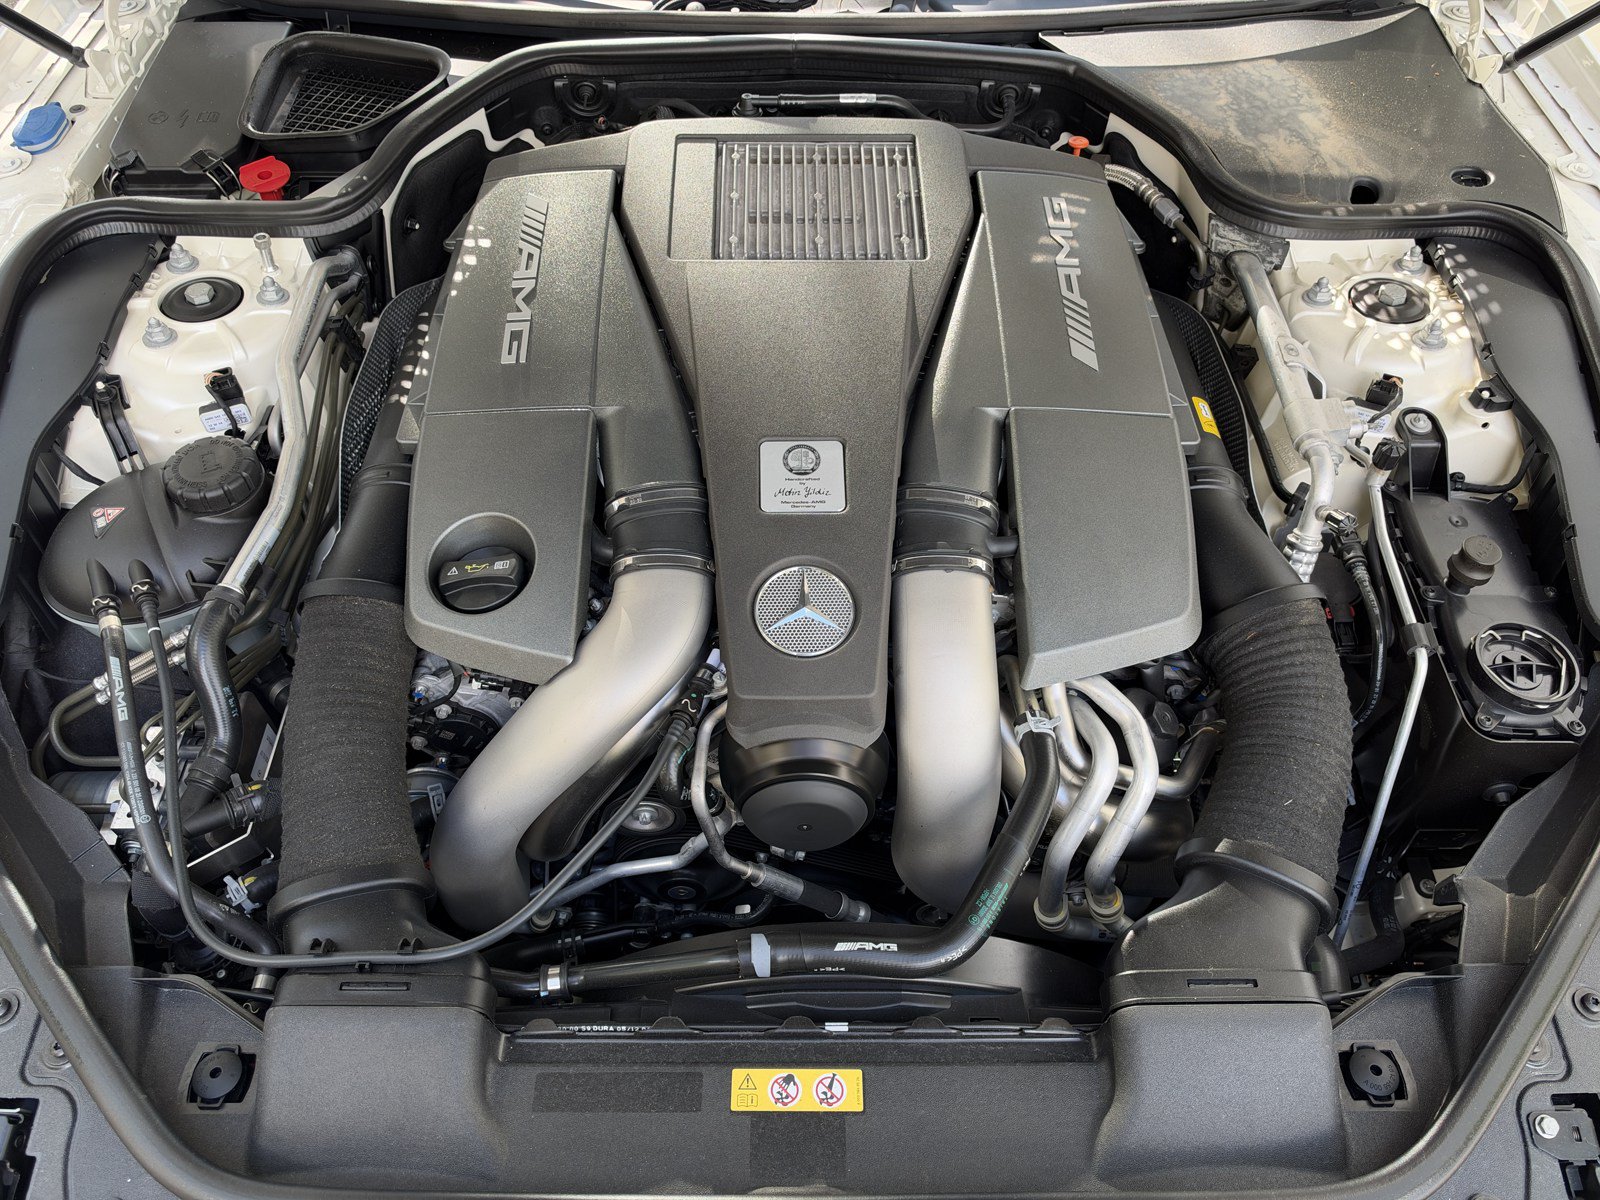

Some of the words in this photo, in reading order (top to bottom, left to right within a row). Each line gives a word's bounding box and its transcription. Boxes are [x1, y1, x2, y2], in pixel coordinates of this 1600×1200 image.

[1042, 196, 1089, 310] AMG
[500, 238, 542, 365] AMG
[113, 676, 129, 721] AMG
[855, 941, 898, 952] AMG
